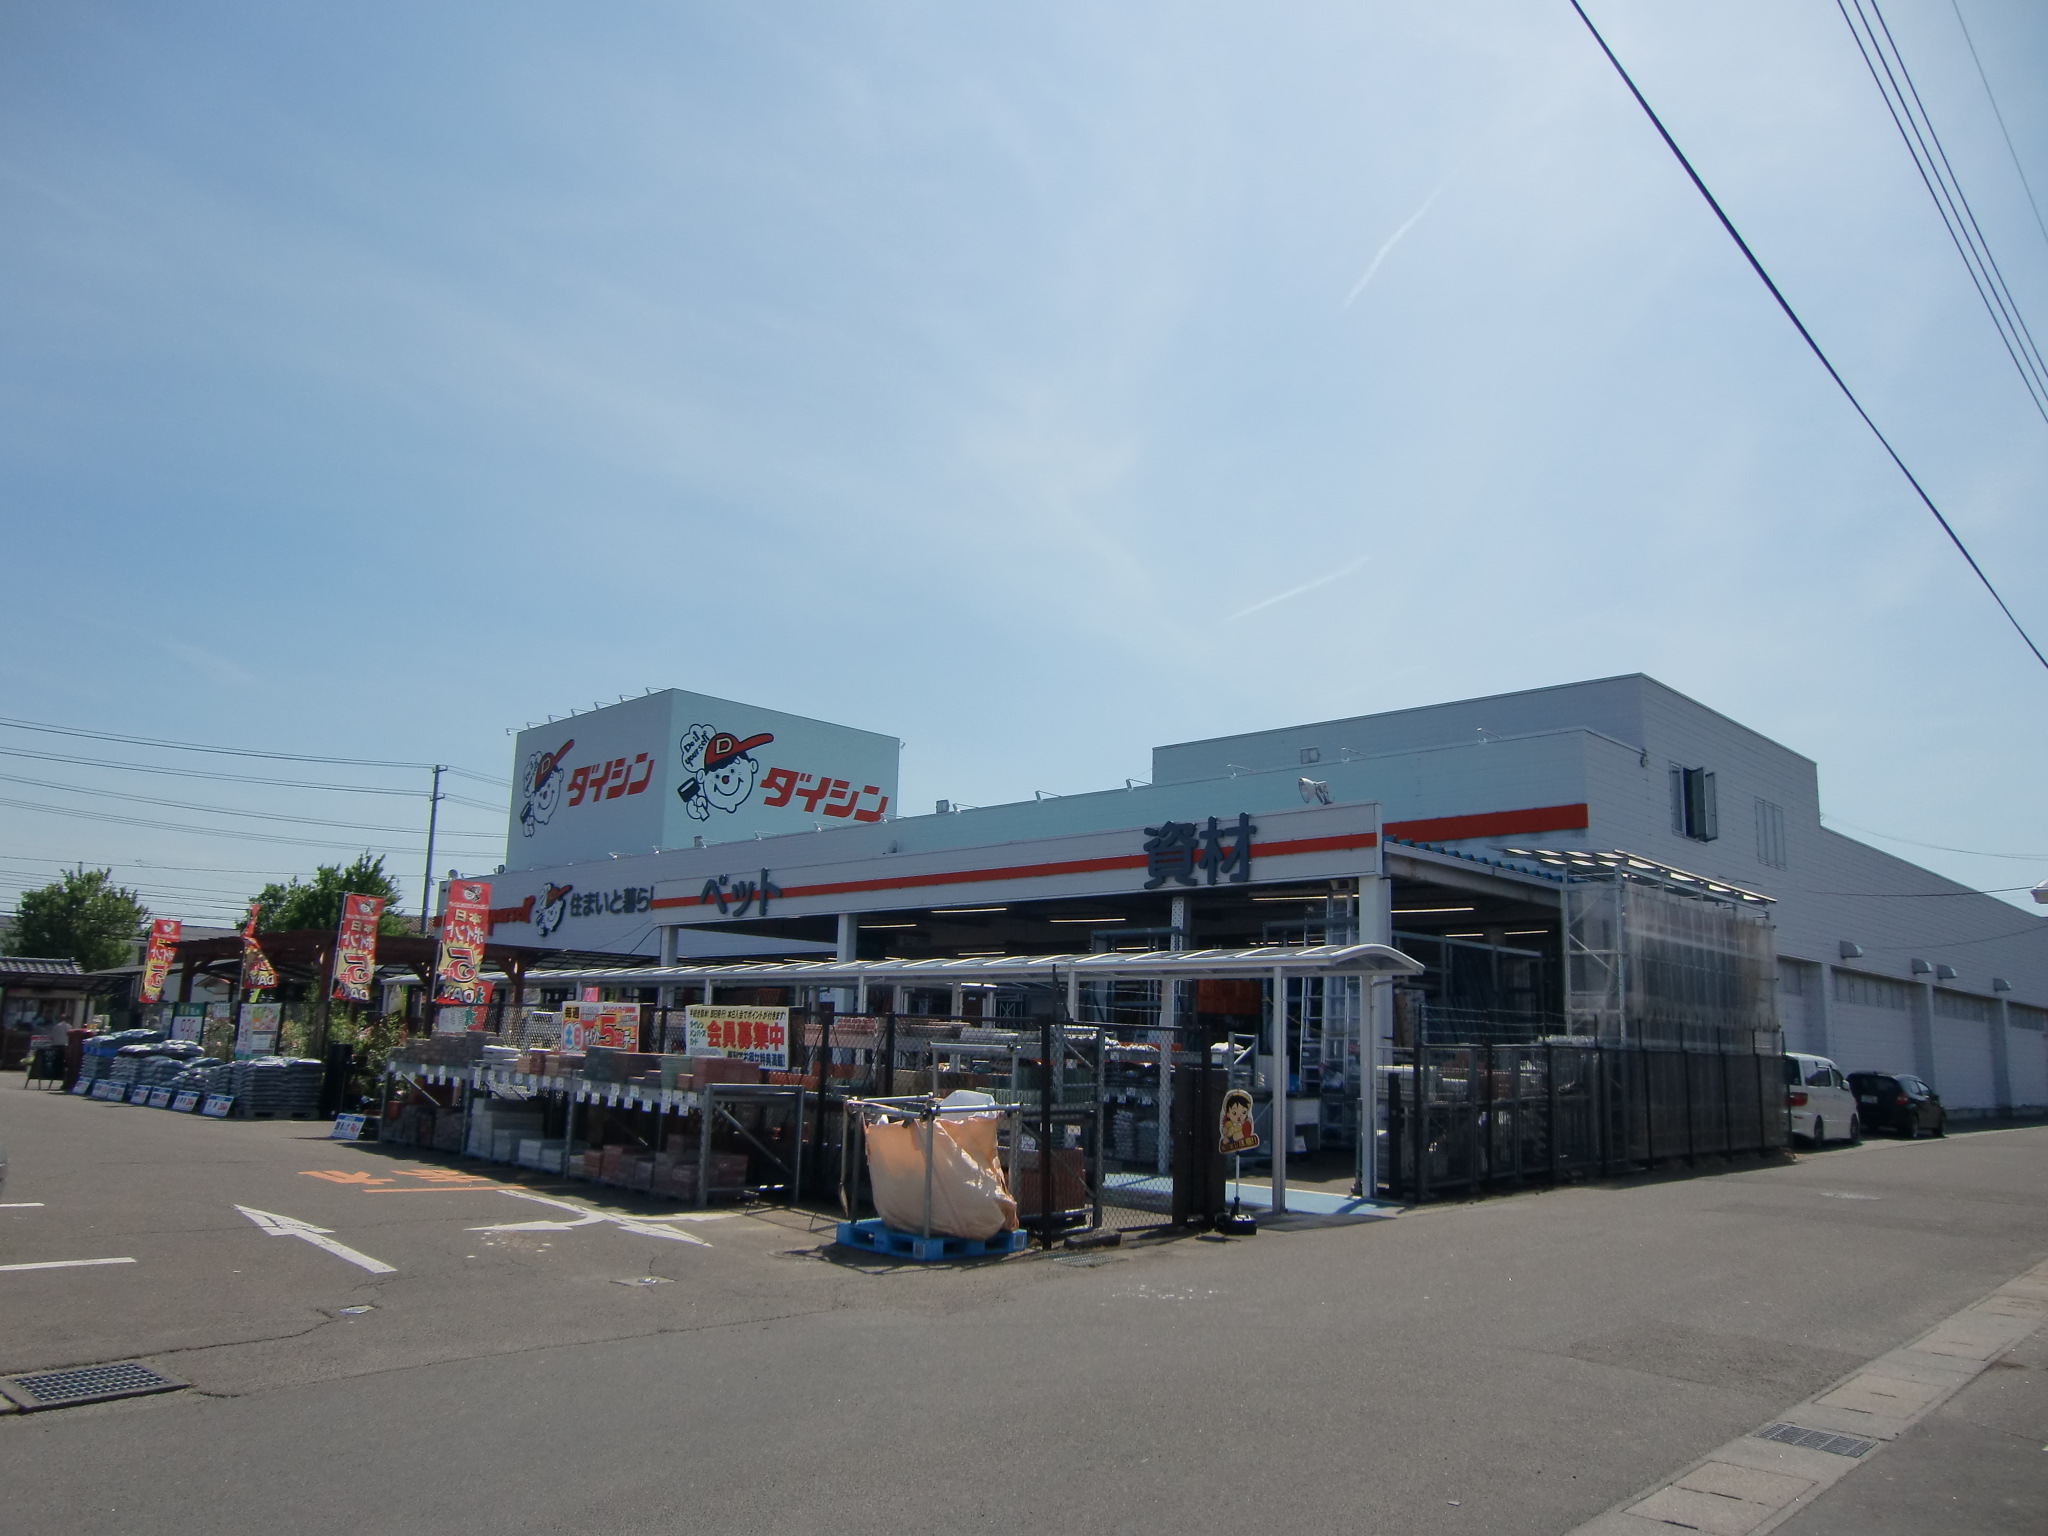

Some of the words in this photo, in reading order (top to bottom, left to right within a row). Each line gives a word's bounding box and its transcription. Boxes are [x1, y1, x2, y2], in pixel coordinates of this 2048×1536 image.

[684, 741, 695, 753] Do
[715, 736, 733, 754] D
[566, 752, 655, 808] ダイシン
[759, 767, 889, 823] ダイシン
[1143, 812, 1257, 890] 資材
[699, 867, 783, 918] ペット
[707, 1020, 785, 1051] 会員募集中
